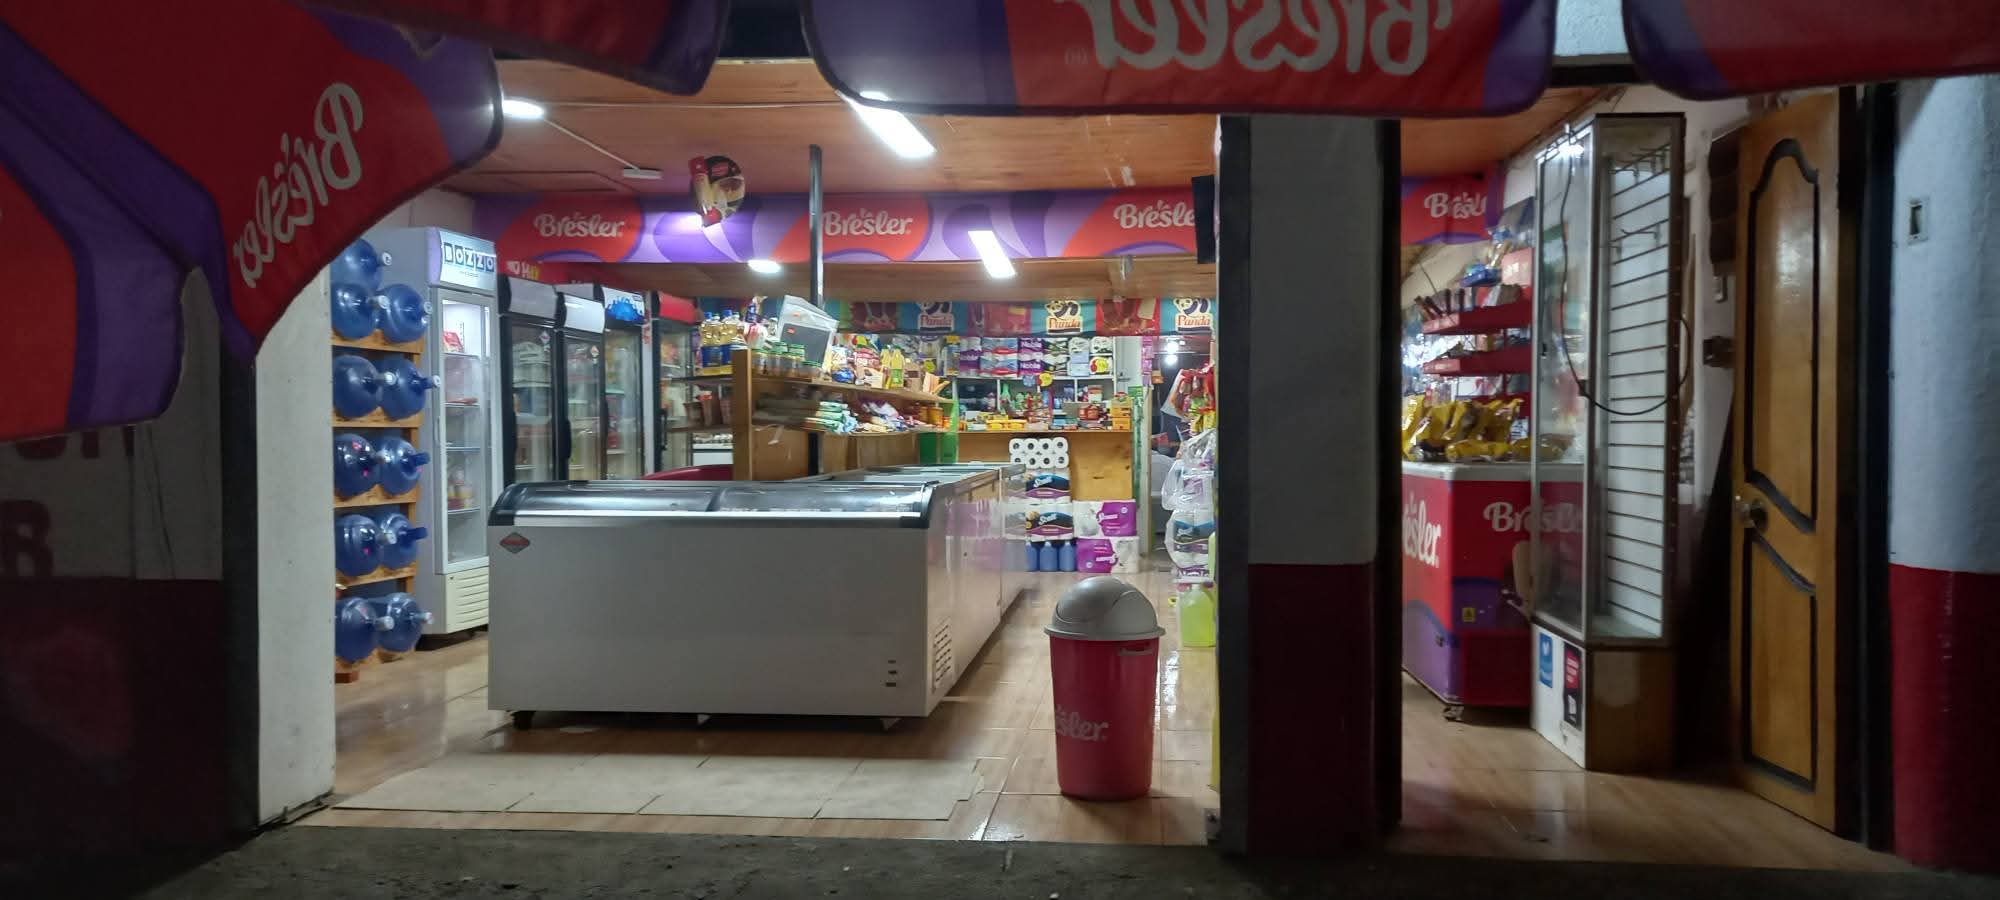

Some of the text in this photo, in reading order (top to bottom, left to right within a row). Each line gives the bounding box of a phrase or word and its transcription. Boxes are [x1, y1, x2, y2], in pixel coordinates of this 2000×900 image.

[533, 212, 625, 237] Bresler
[823, 208, 913, 236] Bresler
[1113, 199, 1196, 229] Bresle
[444, 242, 494, 272] BOZZO
[1049, 317, 1081, 328] Panda
[1178, 314, 1210, 326] Panda
